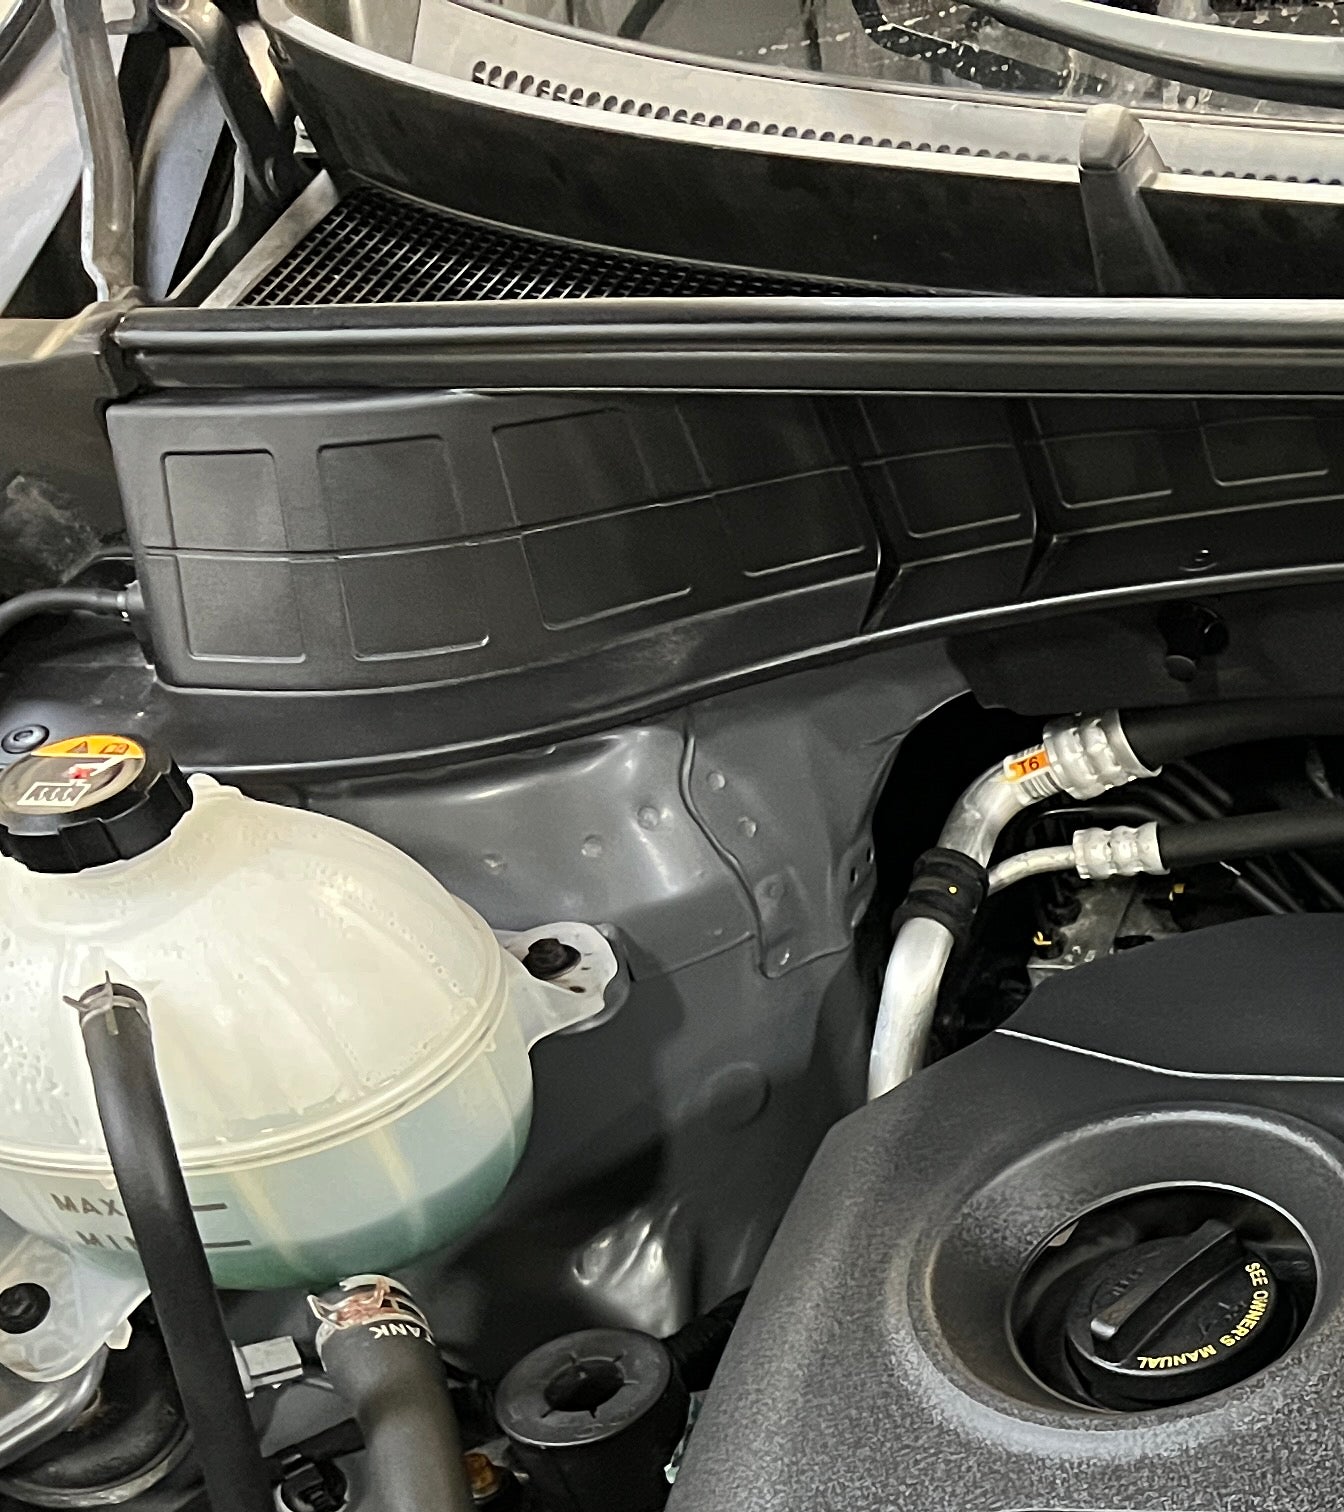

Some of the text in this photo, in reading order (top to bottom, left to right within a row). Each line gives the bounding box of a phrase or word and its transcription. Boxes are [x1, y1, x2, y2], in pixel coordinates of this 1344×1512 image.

[1016, 756, 1040, 775] T6
[51, 1192, 124, 1217] MAX
[1245, 1261, 1270, 1287] SEE
[1219, 1290, 1270, 1348] OWNER'S
[368, 1322, 434, 1345] ANK
[1137, 1344, 1218, 1370] MANUAL
